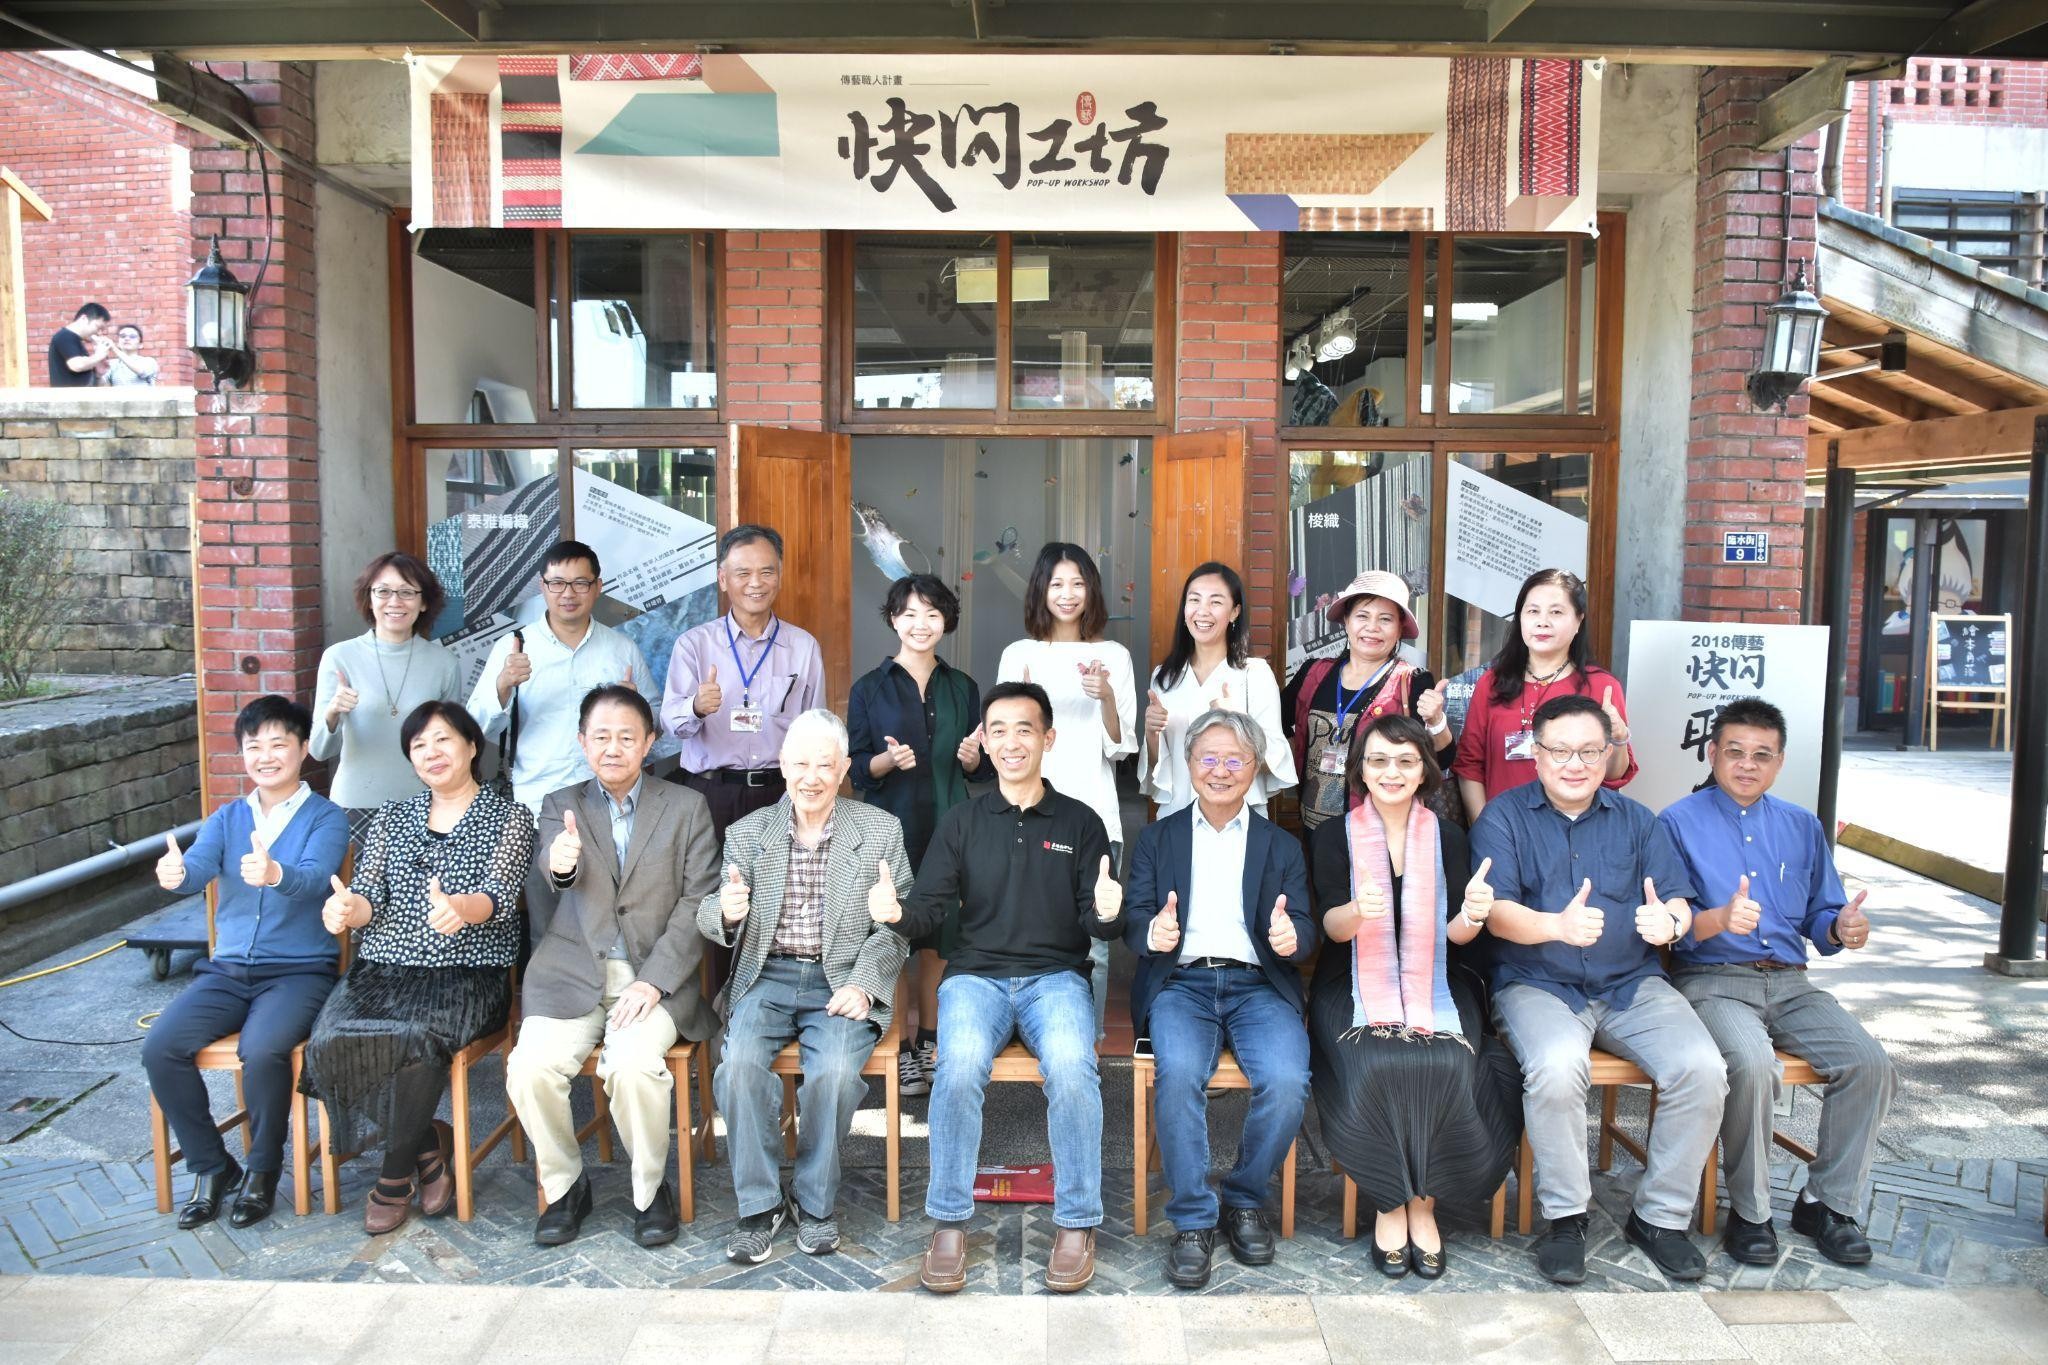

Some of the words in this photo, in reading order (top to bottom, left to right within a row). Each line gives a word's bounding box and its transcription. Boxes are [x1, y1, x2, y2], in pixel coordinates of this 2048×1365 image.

[840, 74, 903, 86] 傳藝職人計畫
[838, 97, 1169, 213] 快閃工坊
[1027, 179, 1061, 188] POP-UP
[1064, 179, 1111, 188] WORKSHOP
[467, 513, 529, 529] 泰雅編織
[1308, 512, 1340, 529] 梭織
[1736, 548, 1745, 560] 9
[1962, 624, 1981, 677] 繪本角落
[1686, 650, 1766, 690] 快閃
[1687, 692, 1717, 700] POP-UP
